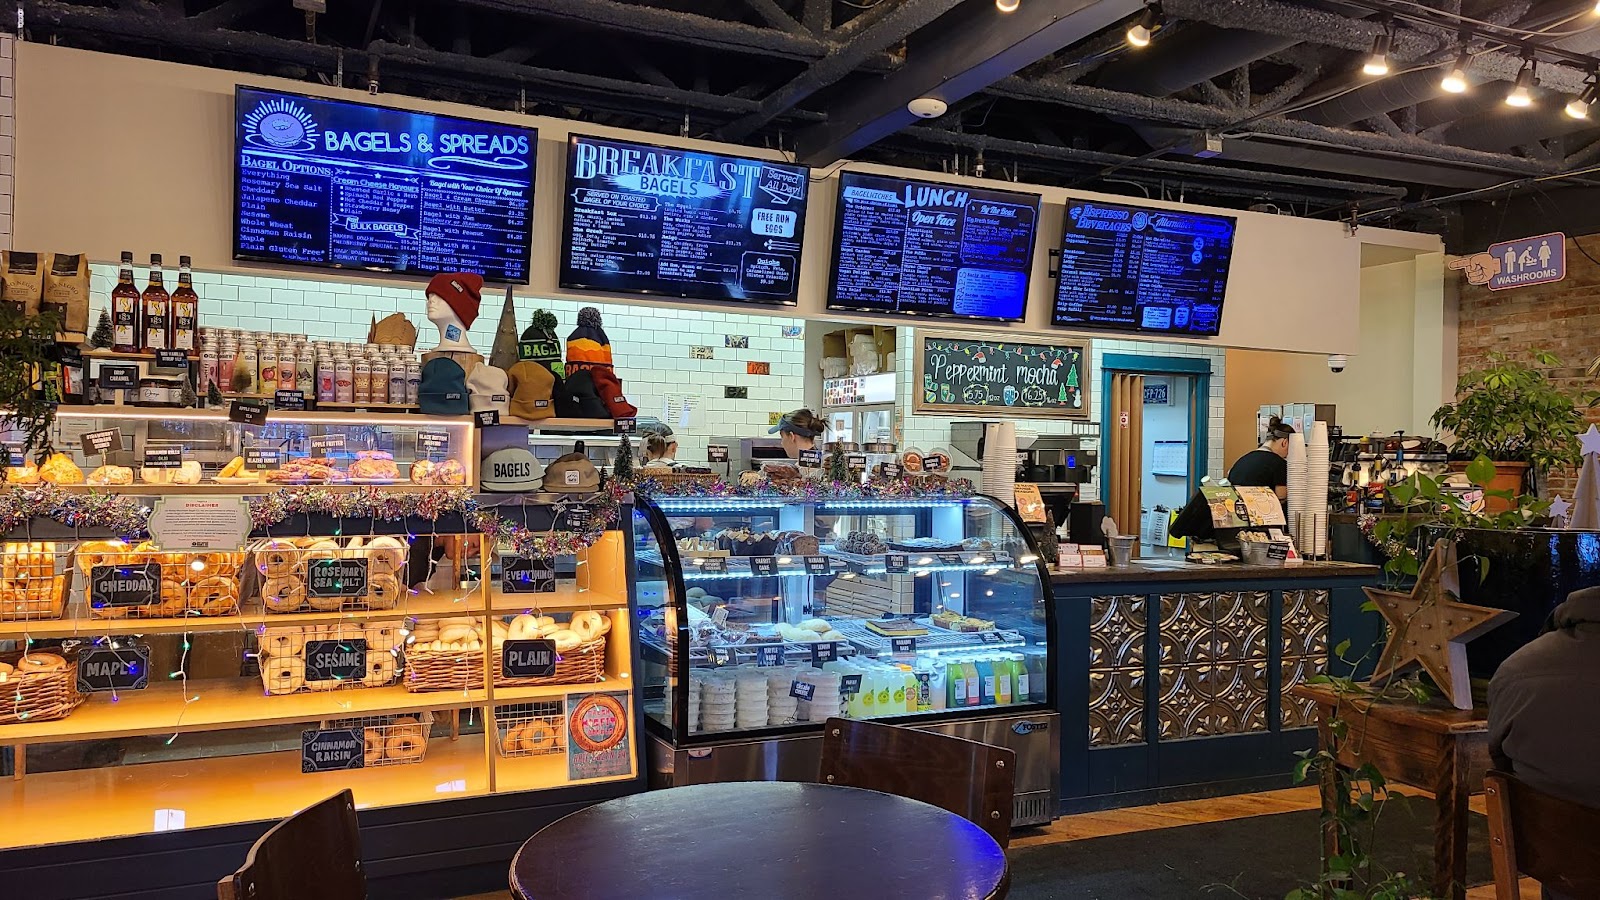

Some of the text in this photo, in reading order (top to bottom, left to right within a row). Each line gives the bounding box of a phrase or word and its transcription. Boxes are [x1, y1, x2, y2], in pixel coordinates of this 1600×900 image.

[324, 131, 529, 155] BAGELS & SPREADS
[241, 155, 280, 170] BAGEL
[241, 168, 290, 180] Everything
[574, 142, 761, 199] BREAKFAST
[767, 168, 799, 184] Served
[241, 177, 322, 192] Rosemary Sea Salt
[333, 176, 387, 190] Cream Cheese
[640, 176, 698, 196] BAGELS
[766, 180, 781, 190] All
[241, 185, 276, 195] Cheddar
[583, 196, 602, 204] BAGEL
[586, 191, 609, 199] SERVED
[620, 194, 647, 203] TOASTED
[905, 184, 969, 209] LUNCH
[241, 202, 266, 210] Plain
[284, 198, 318, 208] Cheddar
[241, 210, 270, 218] Sesame
[574, 207, 604, 215] Breakfast
[1081, 204, 1130, 221] ESPRESSO
[757, 211, 790, 224] FREE RUN
[911, 211, 935, 226] Open
[935, 214, 957, 227] Face
[240, 218, 294, 230] Whole Wheat
[372, 224, 404, 232] BAGELS
[765, 224, 783, 234] EGGS
[1075, 217, 1133, 232] BEVERAGES
[240, 227, 312, 239] Cinnamon Raisin
[240, 234, 265, 243] Maple
[240, 243, 298, 254] Plain Gluten
[1496, 268, 1557, 285] WASHROOMS
[956, 271, 967, 309] WRAPS
[930, 354, 1059, 386] Peppermint mocha
[311, 440, 326, 448] APPLE
[494, 462, 530, 477] BAGELS
[314, 566, 365, 578] ROSEMARY
[505, 569, 553, 581] EVERYTHING
[99, 579, 154, 593] CHEDDAR
[313, 577, 333, 588] SEA
[315, 653, 361, 667] SESAME
[508, 650, 551, 667] PLAIN
[86, 661, 137, 678] MAPLE
[1023, 722, 1048, 731] FOSTER
[311, 740, 357, 752] CINNAMON
[315, 750, 351, 762] RAISIN
